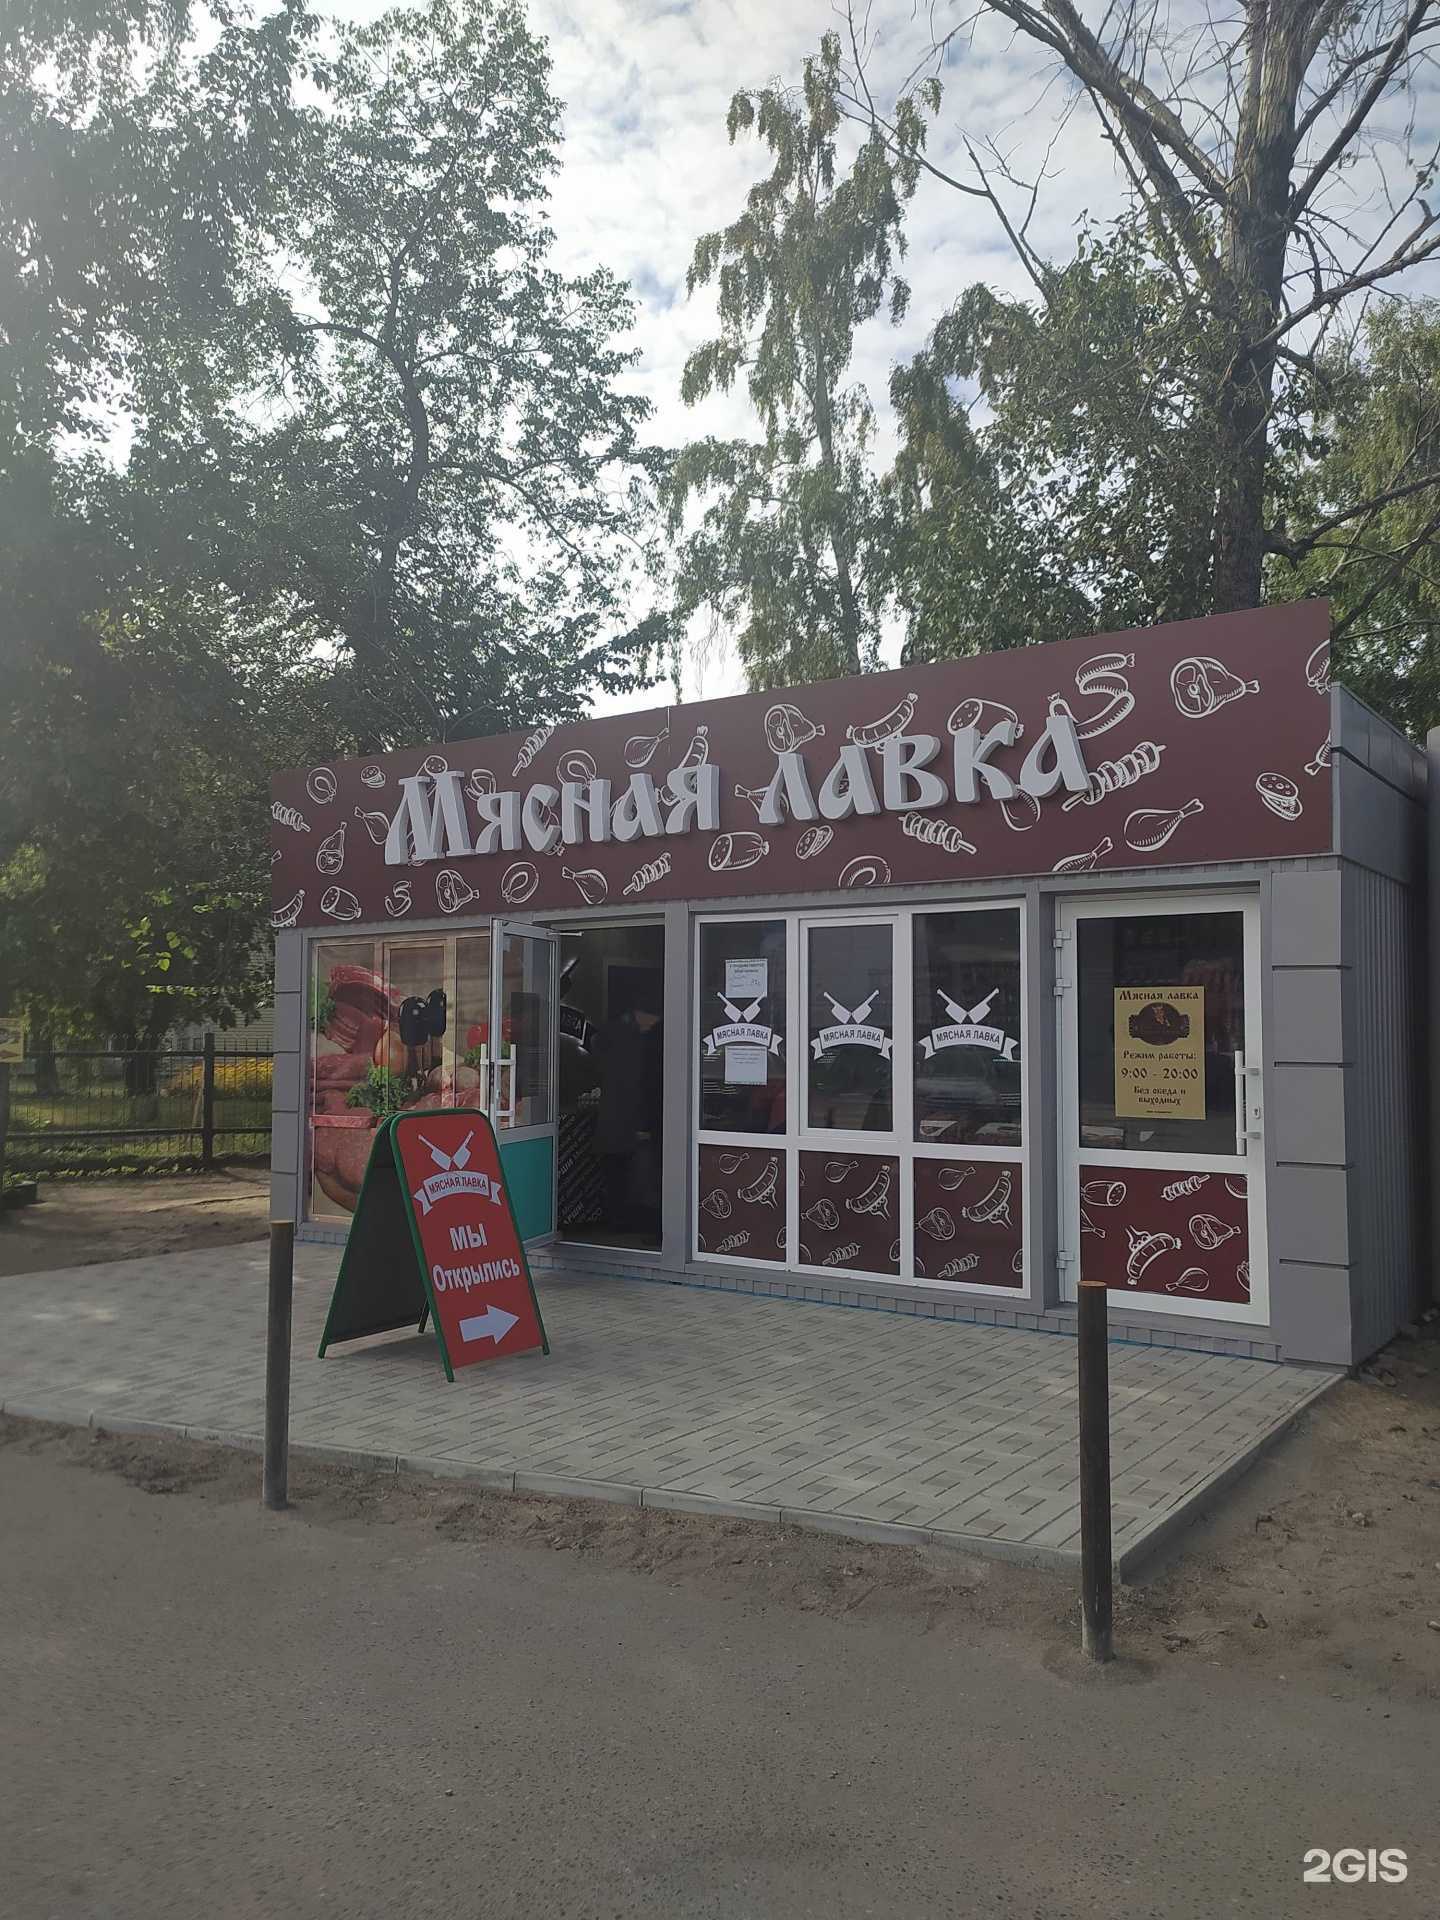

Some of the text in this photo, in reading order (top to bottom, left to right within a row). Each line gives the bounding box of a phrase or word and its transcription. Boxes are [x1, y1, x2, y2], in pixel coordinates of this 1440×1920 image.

[385, 715, 1093, 865] Мясная лавка
[1119, 990, 1163, 1001] Мясная
[716, 1028, 769, 1041] МЯСНАЯ ЛАВКА
[823, 1029, 881, 1043] МЯСНАЯ ЛАВКА
[936, 1030, 1000, 1044] МЯСНАЯ ЛАВКА
[1123, 1050, 1155, 1060] Режим
[1121, 1067, 1148, 1079] 9:00
[1163, 1068, 1199, 1080] 20:00
[429, 1176, 487, 1193] МЯСНАЯ ЛАВКА
[449, 1223, 488, 1252] МЫ
[432, 1258, 520, 1293] Открылись
